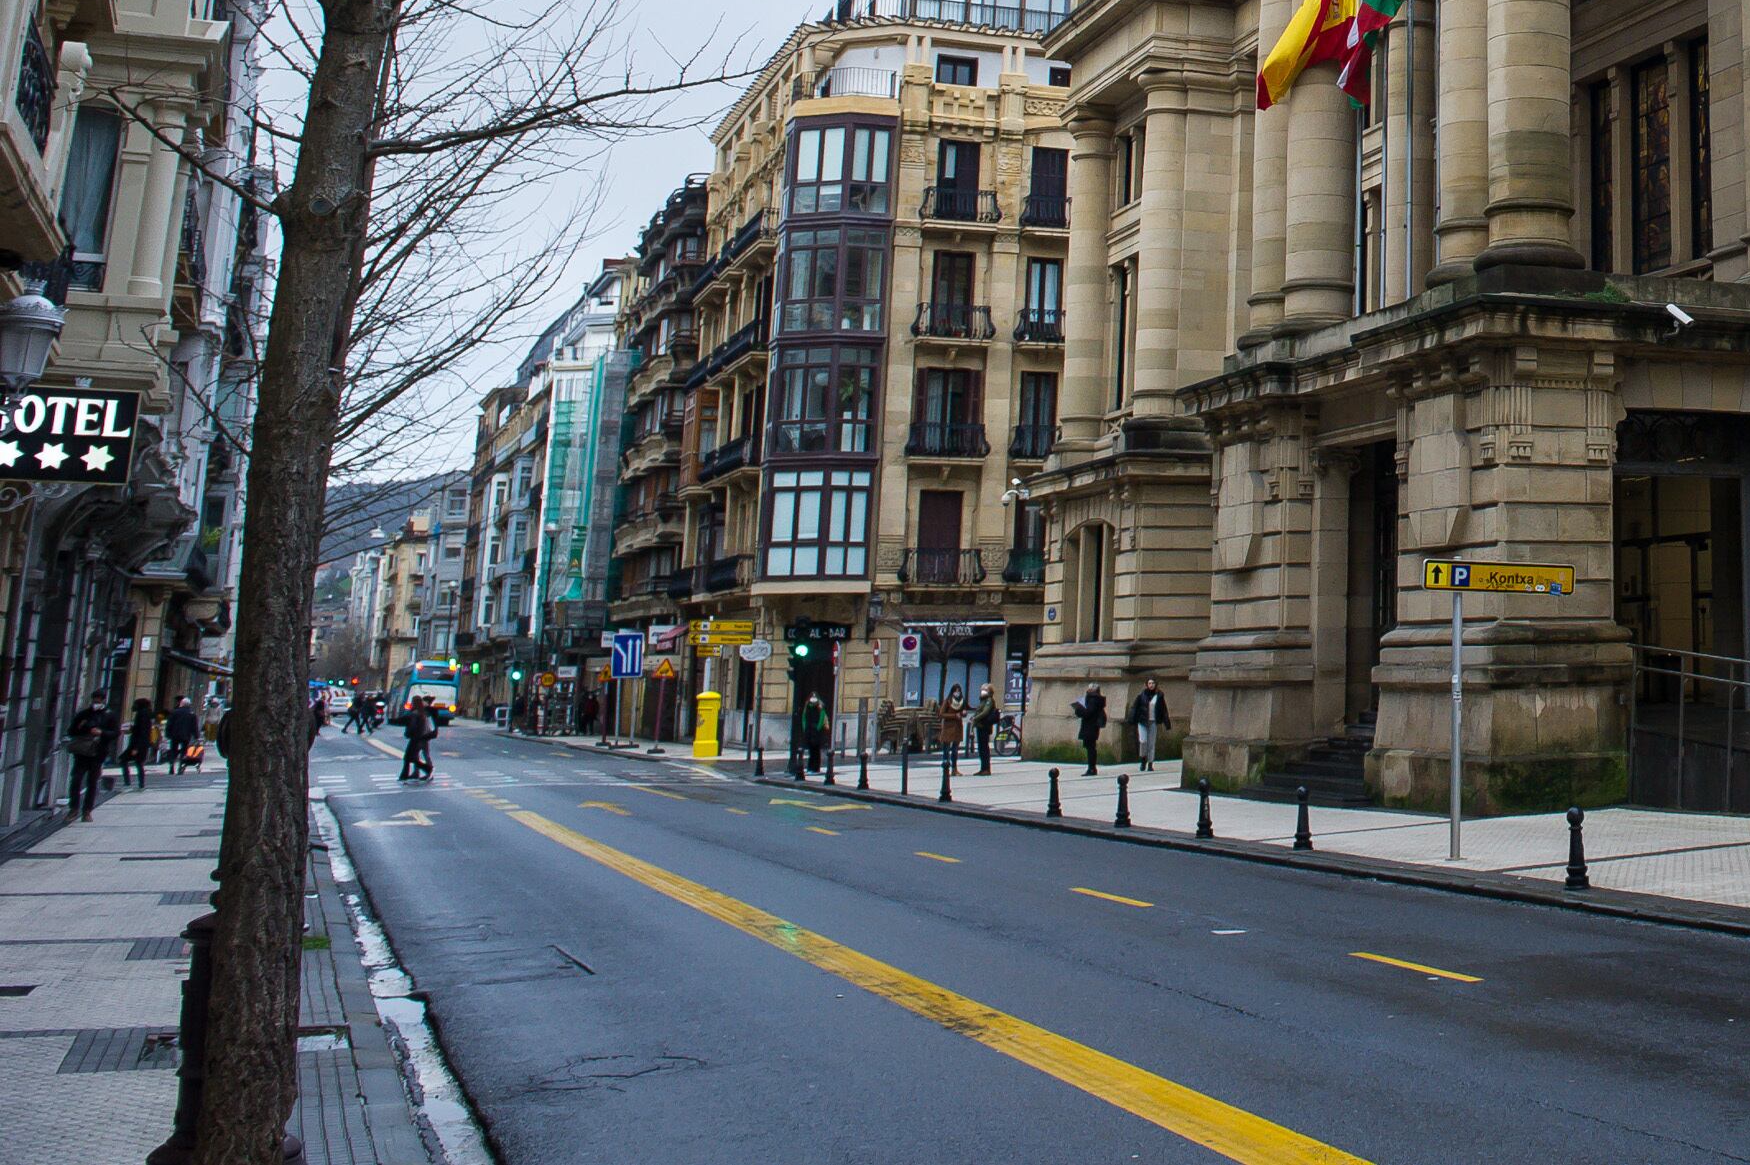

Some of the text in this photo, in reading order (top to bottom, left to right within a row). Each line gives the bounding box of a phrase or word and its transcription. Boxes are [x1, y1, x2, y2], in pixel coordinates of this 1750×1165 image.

[0, 394, 131, 438] OTEL
[1454, 567, 1534, 586] P Kontxa
